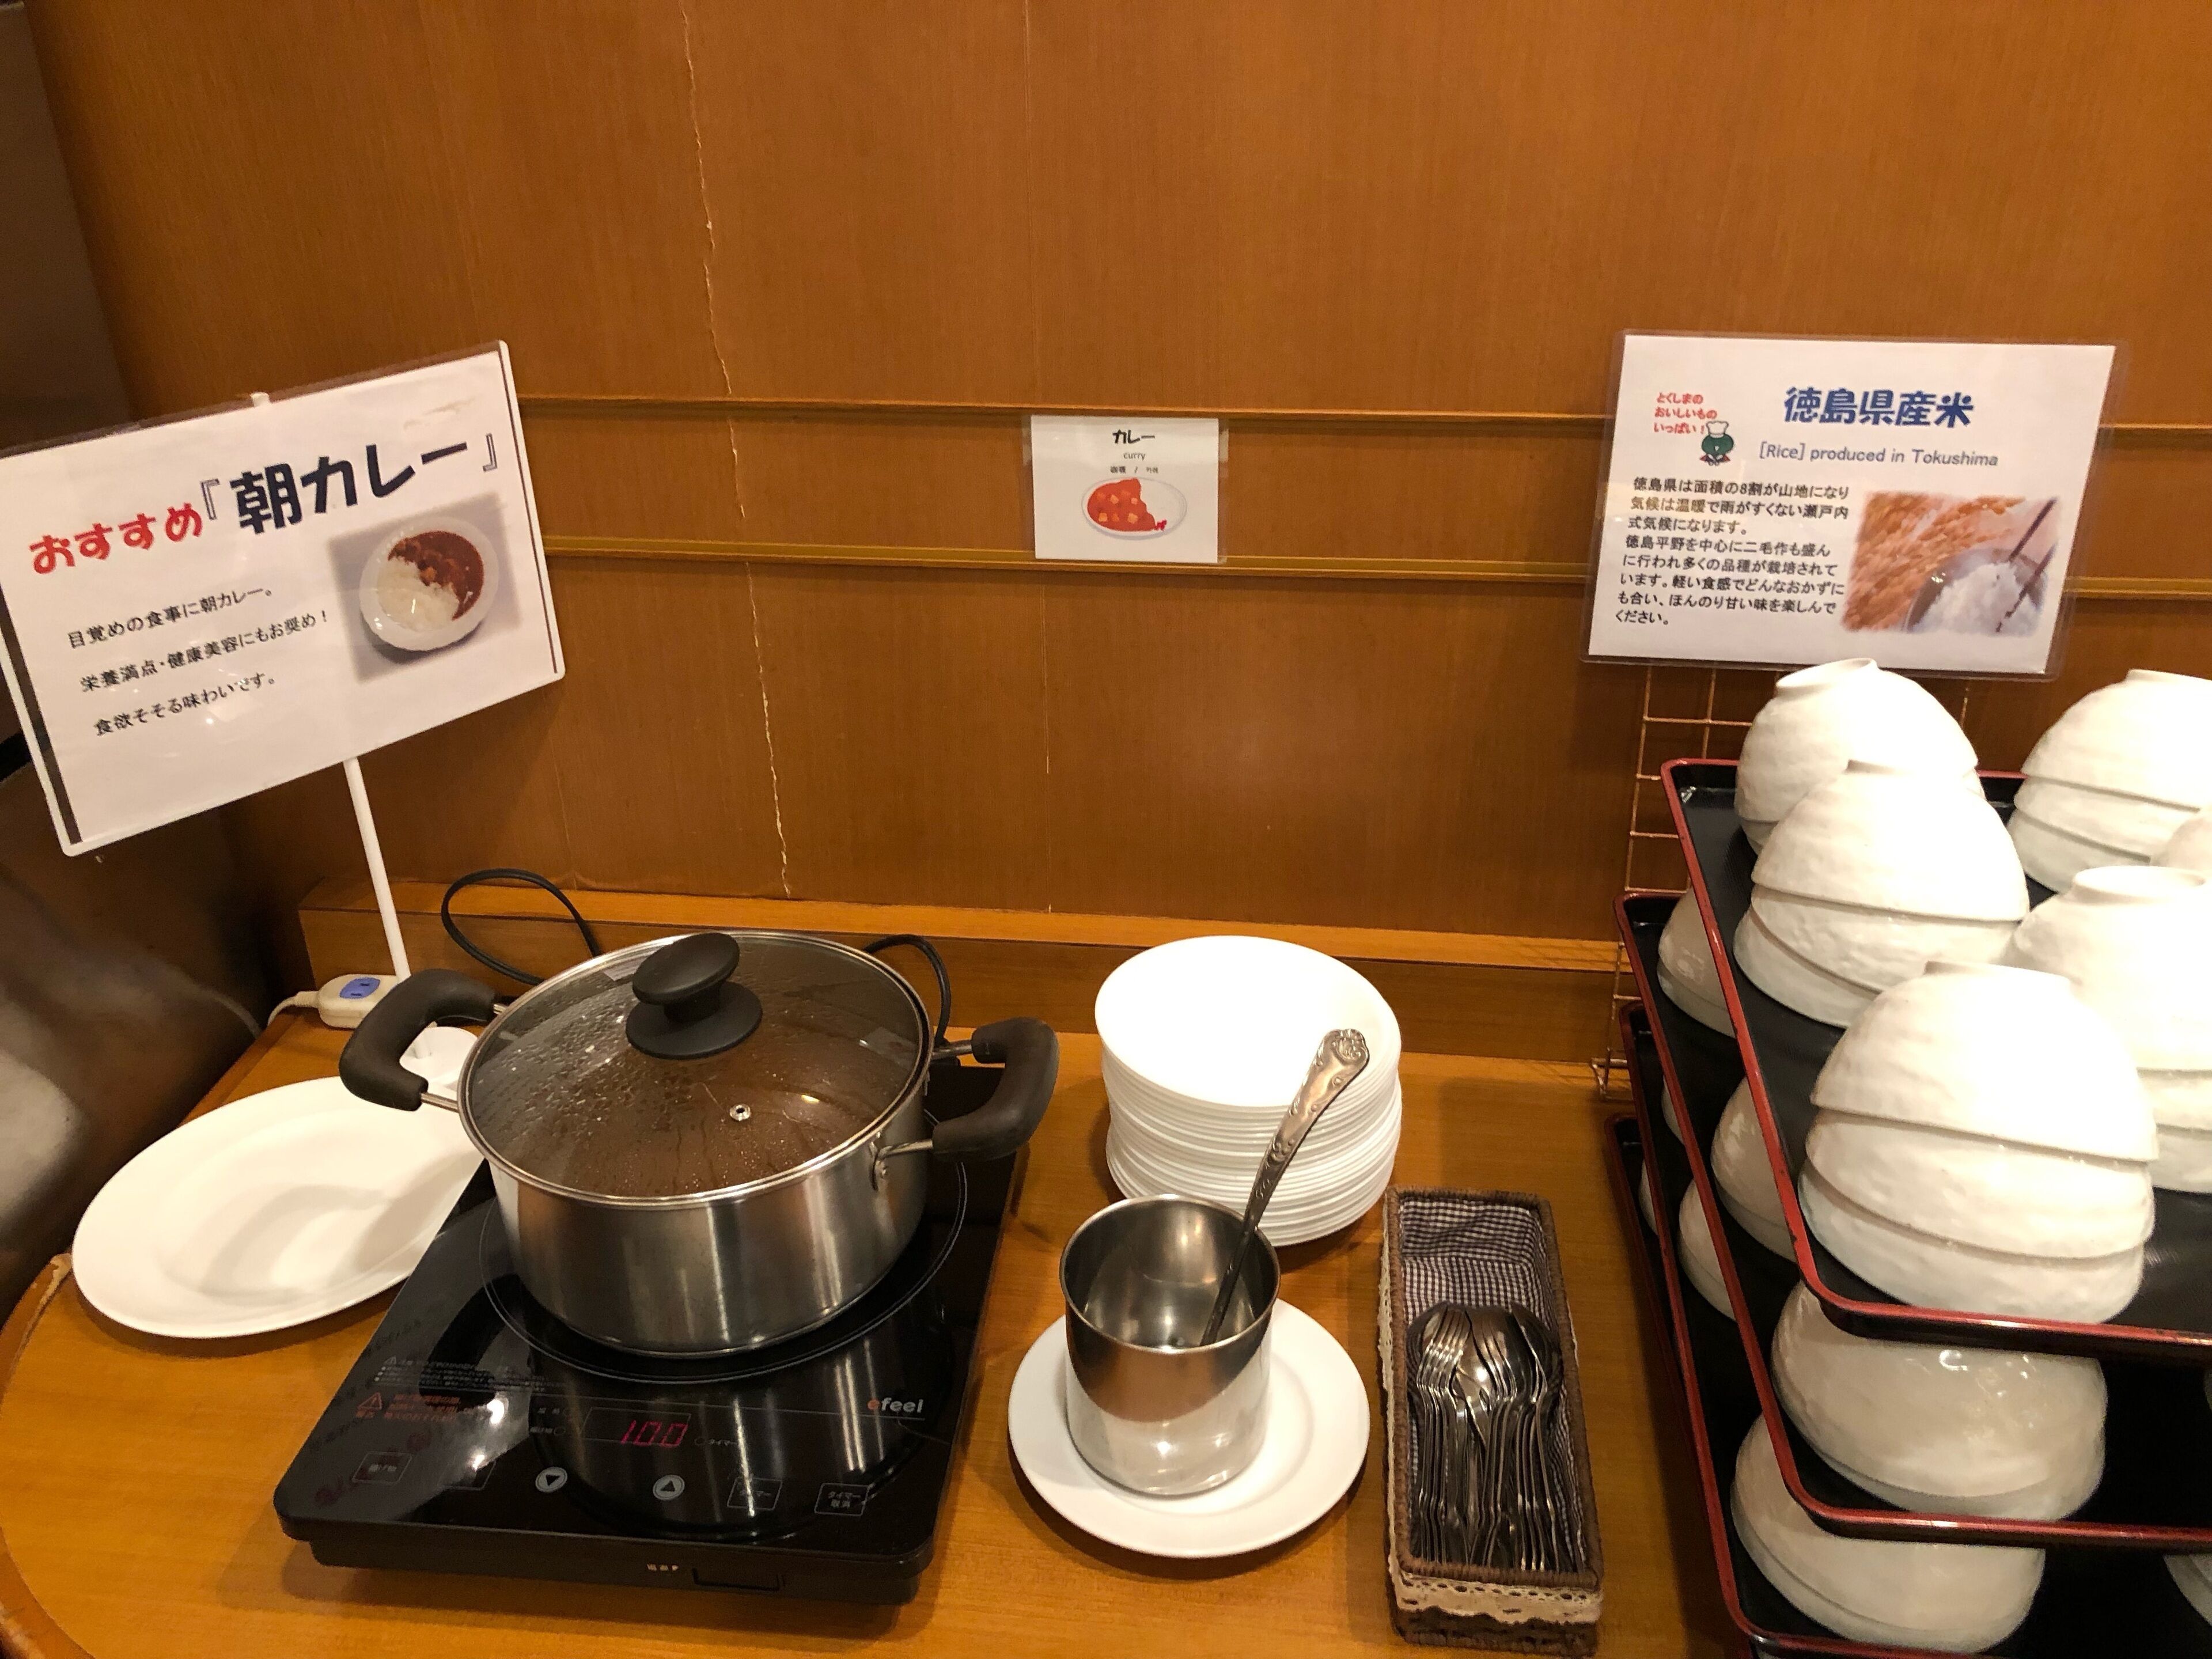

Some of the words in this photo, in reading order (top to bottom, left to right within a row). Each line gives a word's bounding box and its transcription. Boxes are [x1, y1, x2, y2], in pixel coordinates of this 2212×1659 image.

[1657, 392, 1703, 404] とくしまの
[1654, 407, 1717, 419] おいしいもの
[1783, 387, 1974, 428] 徳島県産米
[1112, 429, 1155, 444] カレー
[1123, 453, 1146, 461] curry
[1810, 446, 1887, 463] produced
[1891, 448, 1905, 463] in
[1912, 449, 1998, 466] Tokushima
[68, 588, 271, 649] 目覚めの食事に朝カレー。
[620, 1419, 688, 1447] 100
